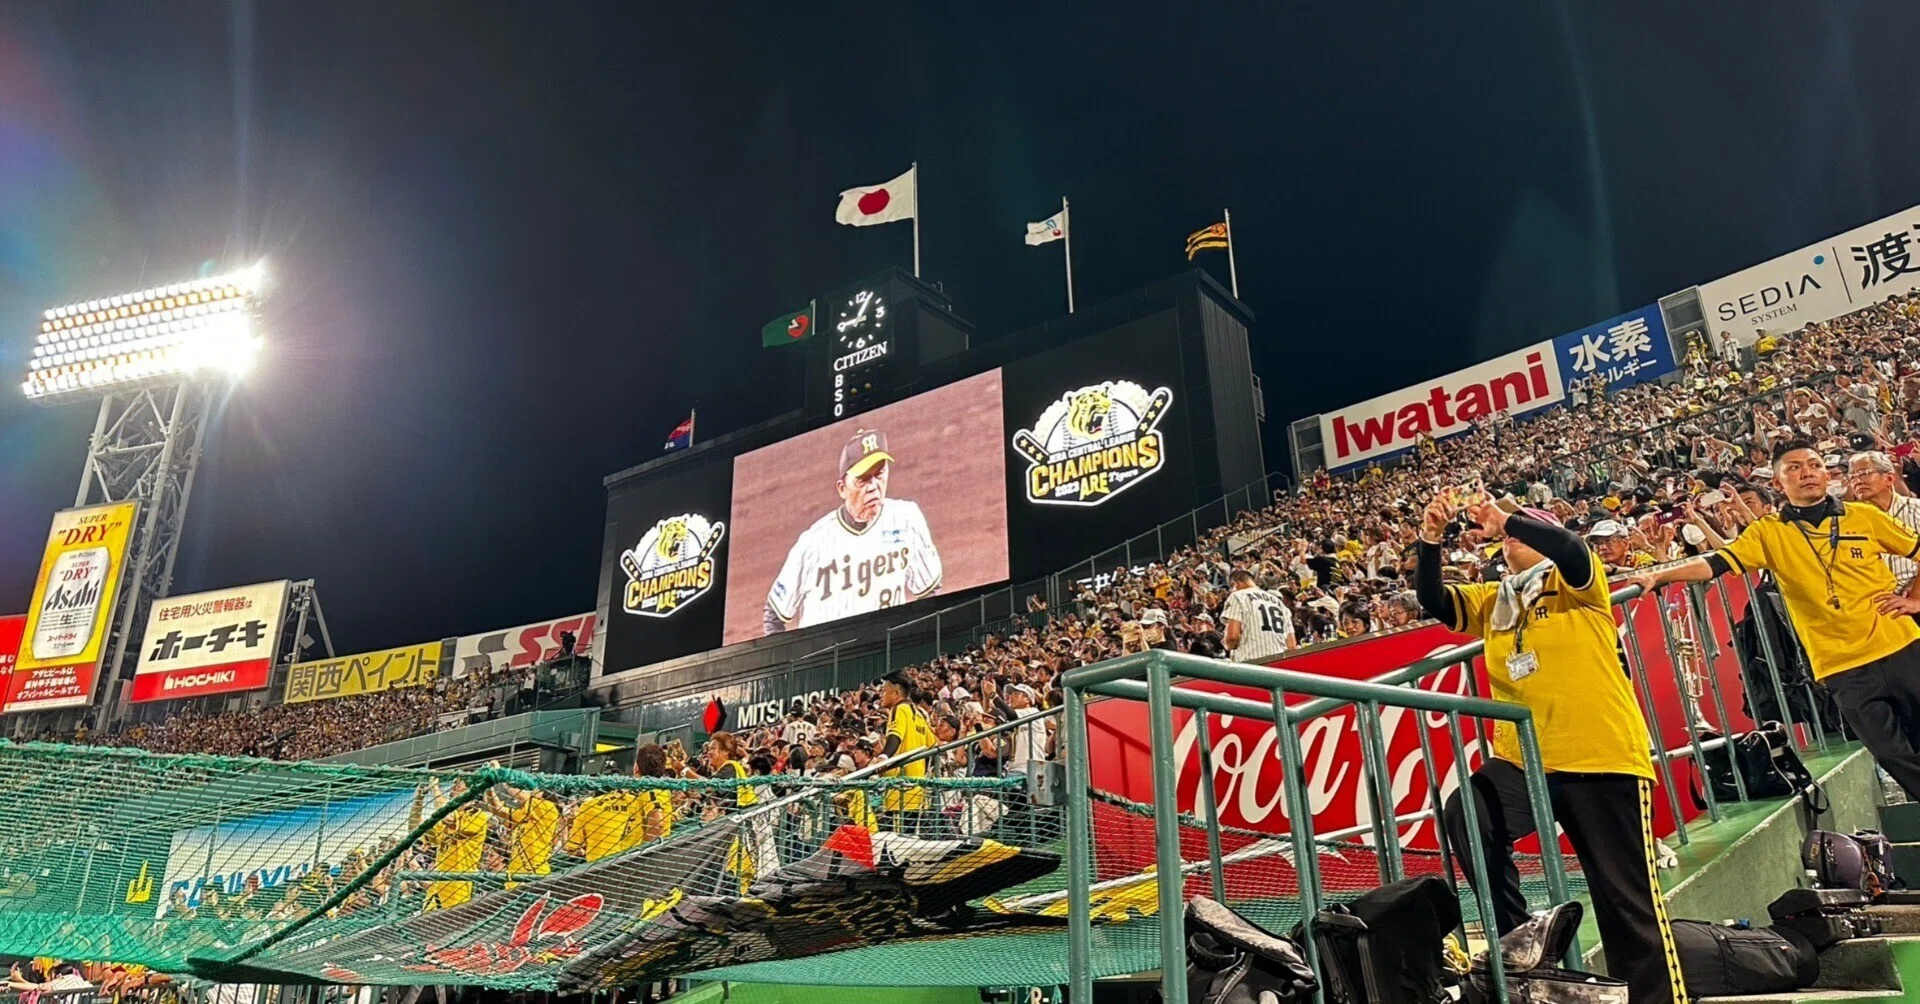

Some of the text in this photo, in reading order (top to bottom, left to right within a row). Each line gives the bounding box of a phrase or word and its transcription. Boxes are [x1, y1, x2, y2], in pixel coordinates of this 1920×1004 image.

[1850, 223, 1920, 290] 渡
[855, 290, 868, 304] 12
[875, 306, 884, 318] 3
[1750, 303, 1798, 326] SYSTEM
[834, 341, 887, 371] CITIZEN
[856, 338, 866, 349] 6
[1568, 317, 1653, 373] 水素
[1567, 358, 1658, 394] ルギー
[1331, 351, 1550, 459] Iwatani
[1031, 435, 1159, 497] CHAMPIONS
[1079, 472, 1110, 501] ARE
[77, 513, 108, 526] SUPER
[626, 560, 711, 608] CHAMPIONS
[816, 547, 909, 601] Tigers
[44, 578, 101, 612] Asahi
[158, 596, 253, 622] 住宅用火災警報器は
[59, 613, 74, 626] 生
[1258, 603, 1285, 634] 16
[148, 619, 268, 662] ホーチキ
[173, 669, 236, 688] HOCHIKI
[286, 647, 437, 700] 関西ペイント
